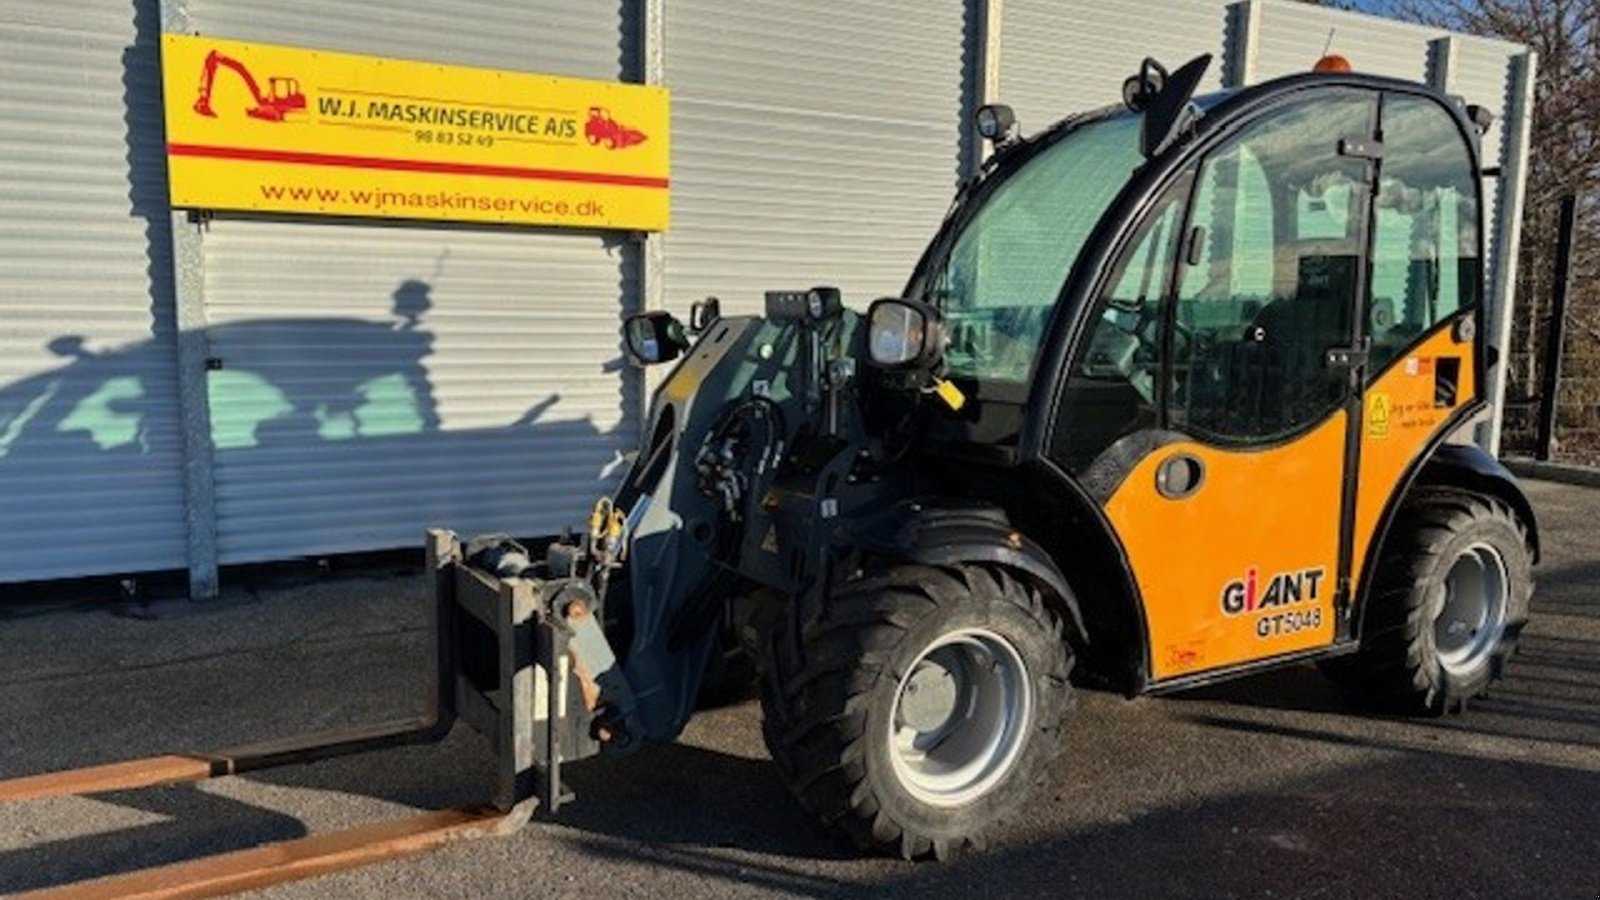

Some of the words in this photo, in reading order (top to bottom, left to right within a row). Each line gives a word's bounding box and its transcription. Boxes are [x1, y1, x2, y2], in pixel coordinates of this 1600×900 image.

[318, 97, 361, 118] W.J.
[367, 102, 539, 135] MASKINSERVICE
[543, 117, 577, 138] A/S
[415, 130, 433, 143] 98
[457, 132, 473, 146] 52
[478, 135, 494, 148] 49
[260, 184, 605, 217] www.wjmaskinservice.dk
[1257, 608, 1321, 637] GT5048
